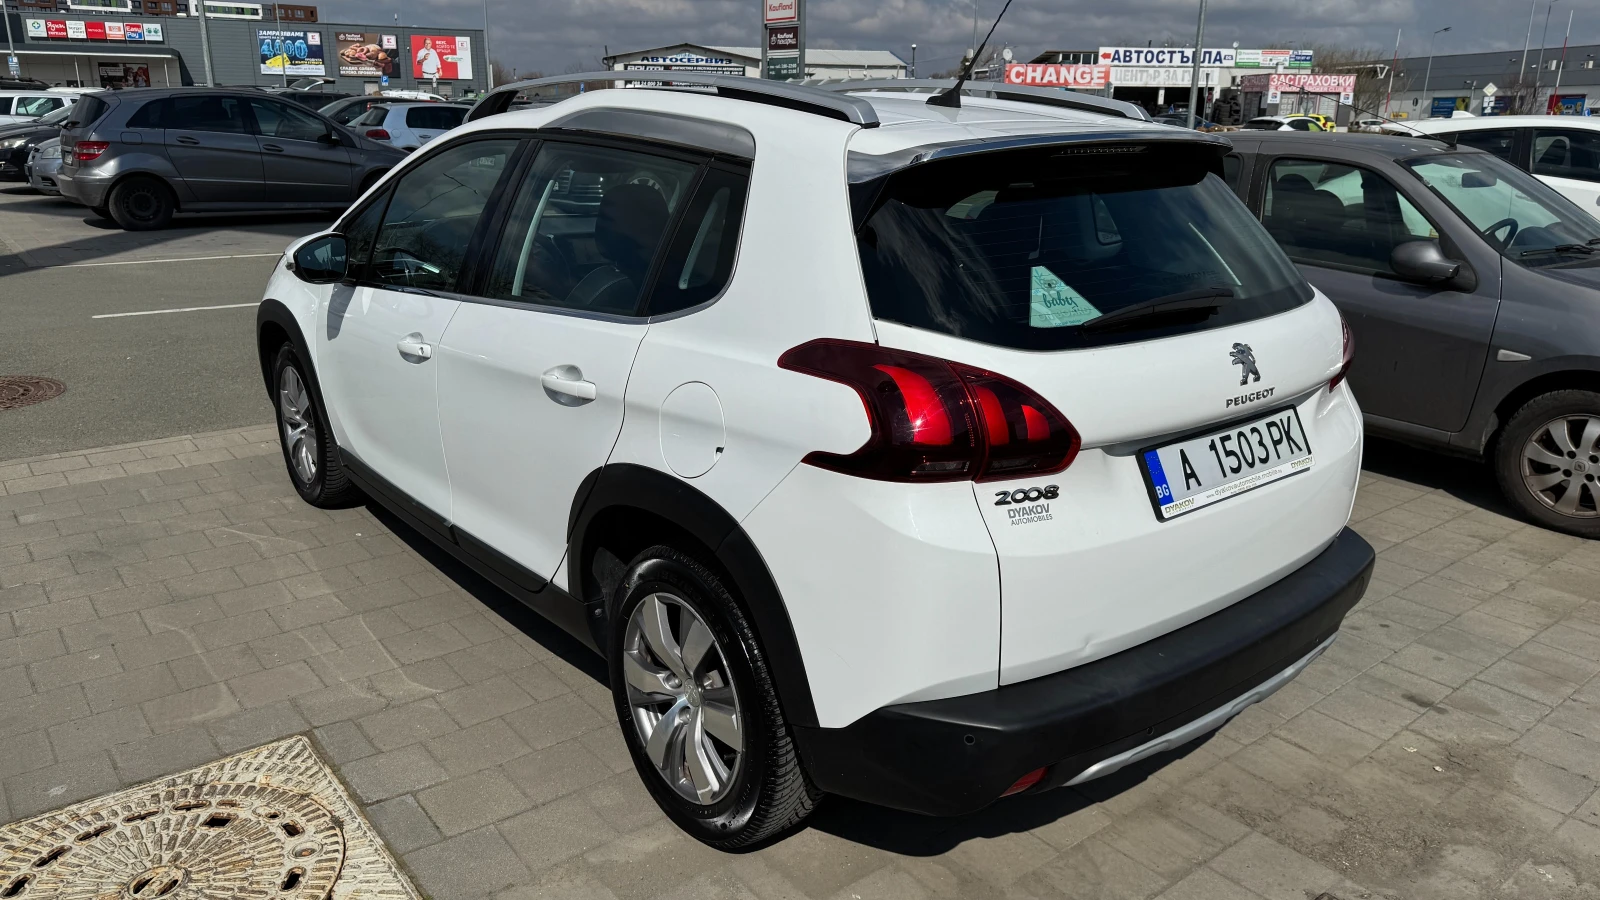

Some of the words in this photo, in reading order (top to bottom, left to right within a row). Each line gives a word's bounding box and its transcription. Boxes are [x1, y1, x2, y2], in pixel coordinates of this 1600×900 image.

[769, 2, 793, 12] Kaufland
[261, 39, 308, 59] 4000
[1111, 50, 1223, 64] АВТОСТЪЛА
[641, 56, 733, 65] АВТОСЕРВИЗ
[1010, 66, 1107, 84] CHANGE
[1115, 69, 1161, 83] ЦЕНТЪР
[1164, 69, 1178, 82] ЗА
[1270, 74, 1354, 86] ЗАСТРАХОВКИ
[1043, 290, 1078, 309] baby
[1225, 387, 1275, 408] PEUGEOT
[1179, 448, 1202, 491] A
[1208, 426, 1270, 479] 1503
[1265, 415, 1303, 460] PK
[994, 484, 1060, 506] 2008
[1155, 484, 1170, 498] BG
[1007, 503, 1050, 519] DYAKOV
[1165, 498, 1195, 514] DYAKOV
[1010, 513, 1053, 527] AUTOMOBILES
